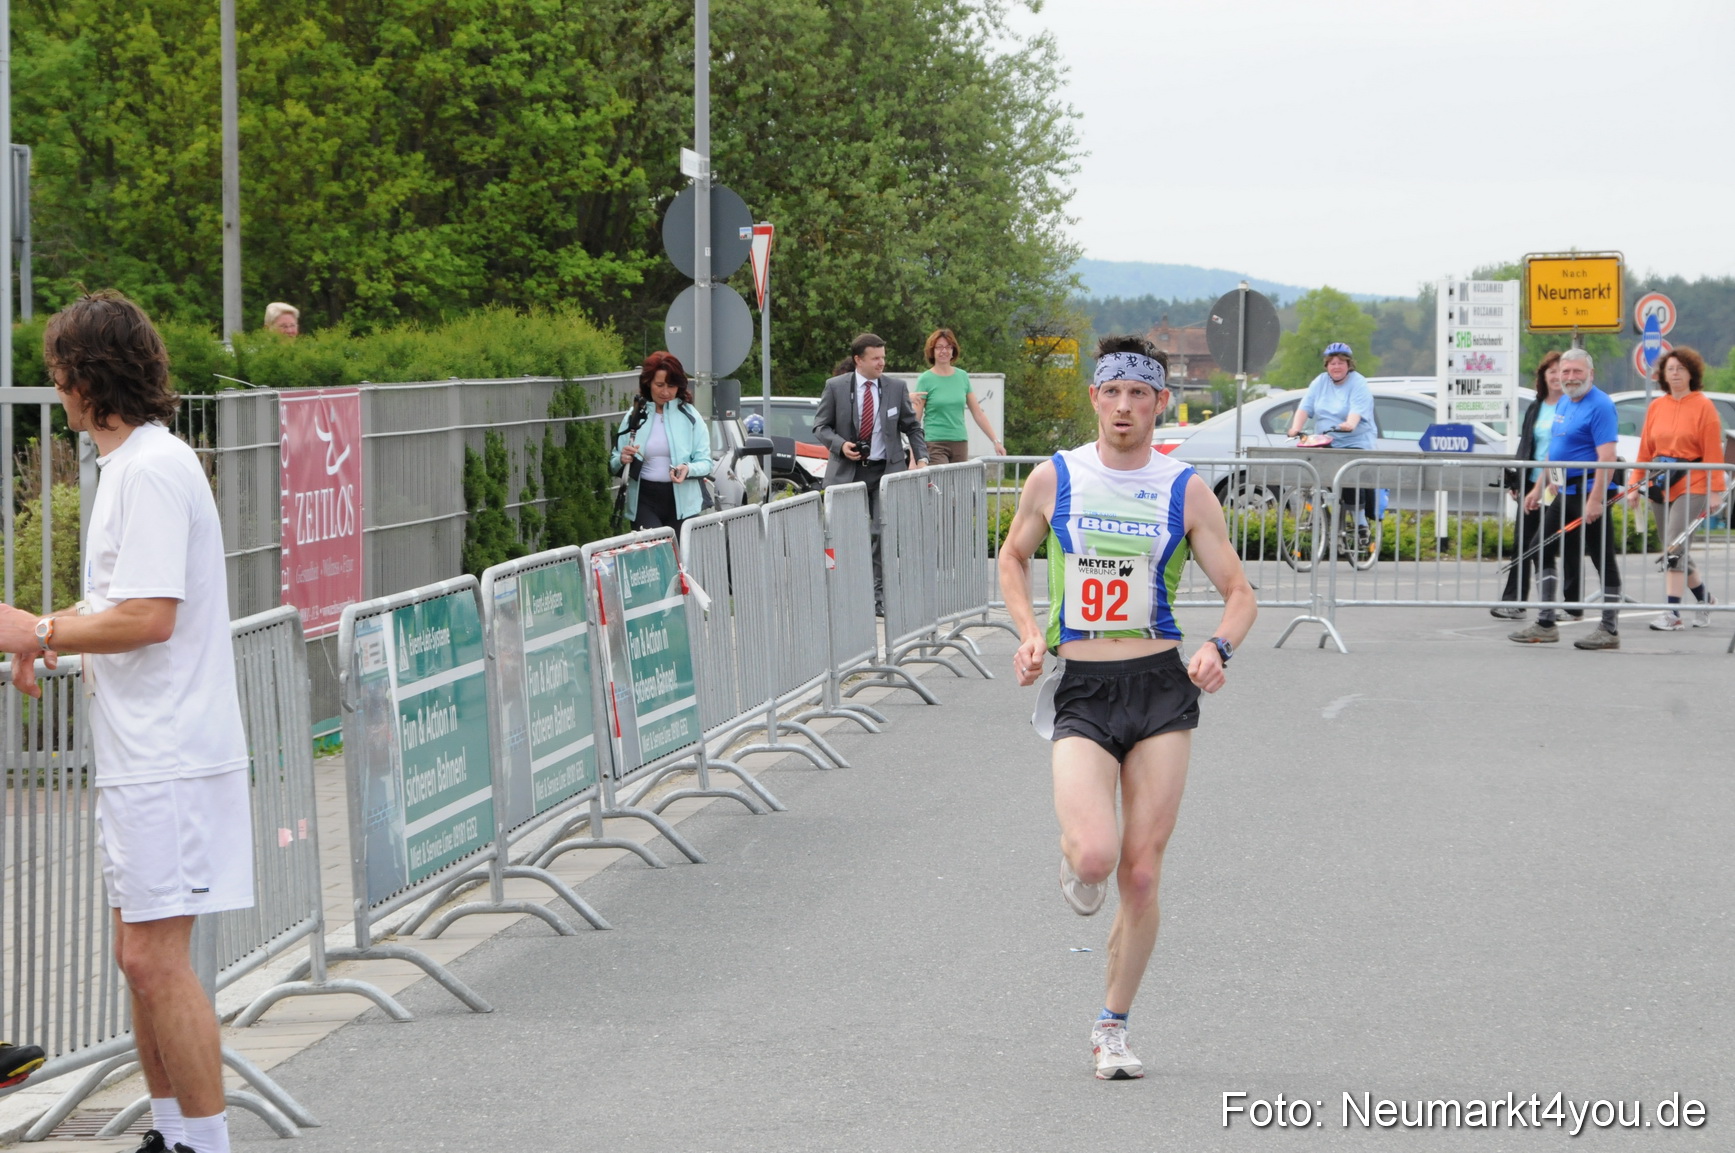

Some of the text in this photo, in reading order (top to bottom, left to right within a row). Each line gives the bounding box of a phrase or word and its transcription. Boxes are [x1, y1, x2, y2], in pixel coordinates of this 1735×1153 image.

[1562, 269, 1587, 278] Nach
[1537, 283, 1612, 300] Neumarkt
[1563, 306, 1588, 316] 5 km
[1456, 331, 1472, 348] SHB
[1455, 378, 1481, 395] THULE
[1430, 436, 1469, 451] VOLVO
[280, 404, 290, 608] EITLOS
[295, 483, 354, 546] ZEITLOS
[1078, 516, 1161, 537] BOCK
[1078, 558, 1116, 569] MEYER
[1078, 567, 1117, 576] WERBUNG
[1081, 578, 1129, 622] 92
[402, 695, 458, 752] Fun & Action in
